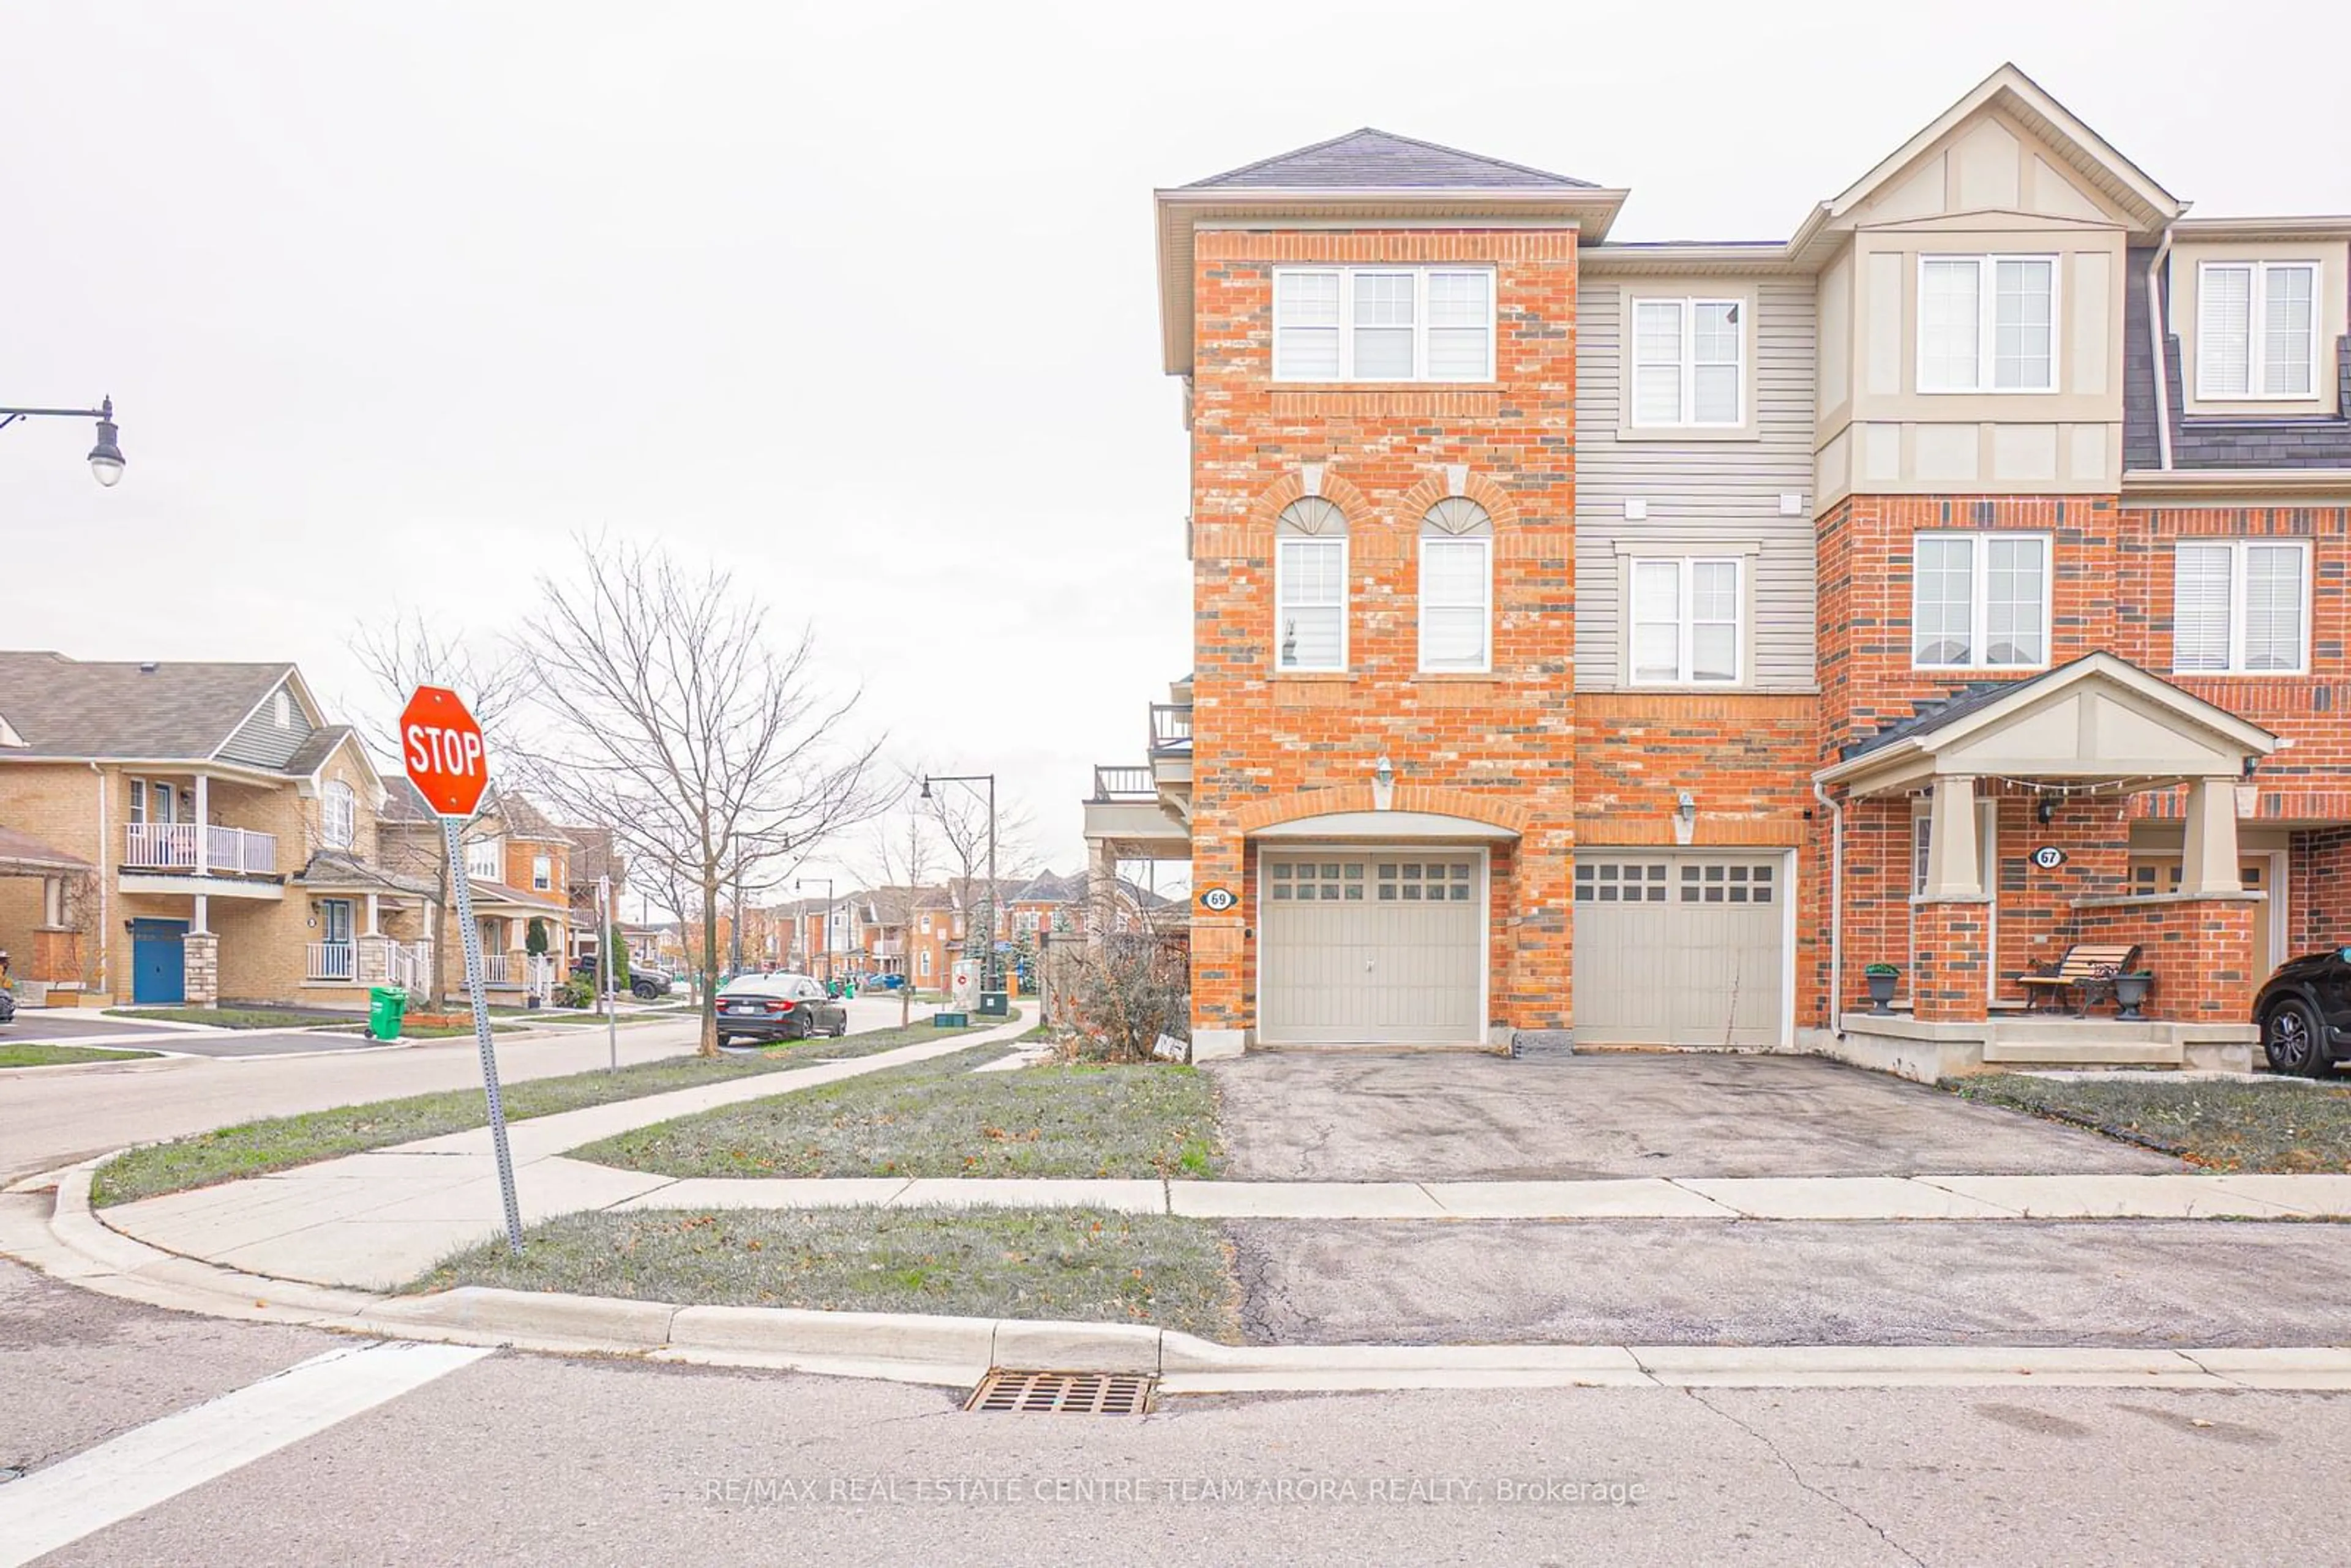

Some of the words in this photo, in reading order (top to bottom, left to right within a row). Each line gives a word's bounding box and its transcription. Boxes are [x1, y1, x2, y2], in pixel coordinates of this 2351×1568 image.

[408, 725, 481, 776] STOP
[2041, 852, 2056, 863] 67
[1212, 893, 1226, 905] 69
